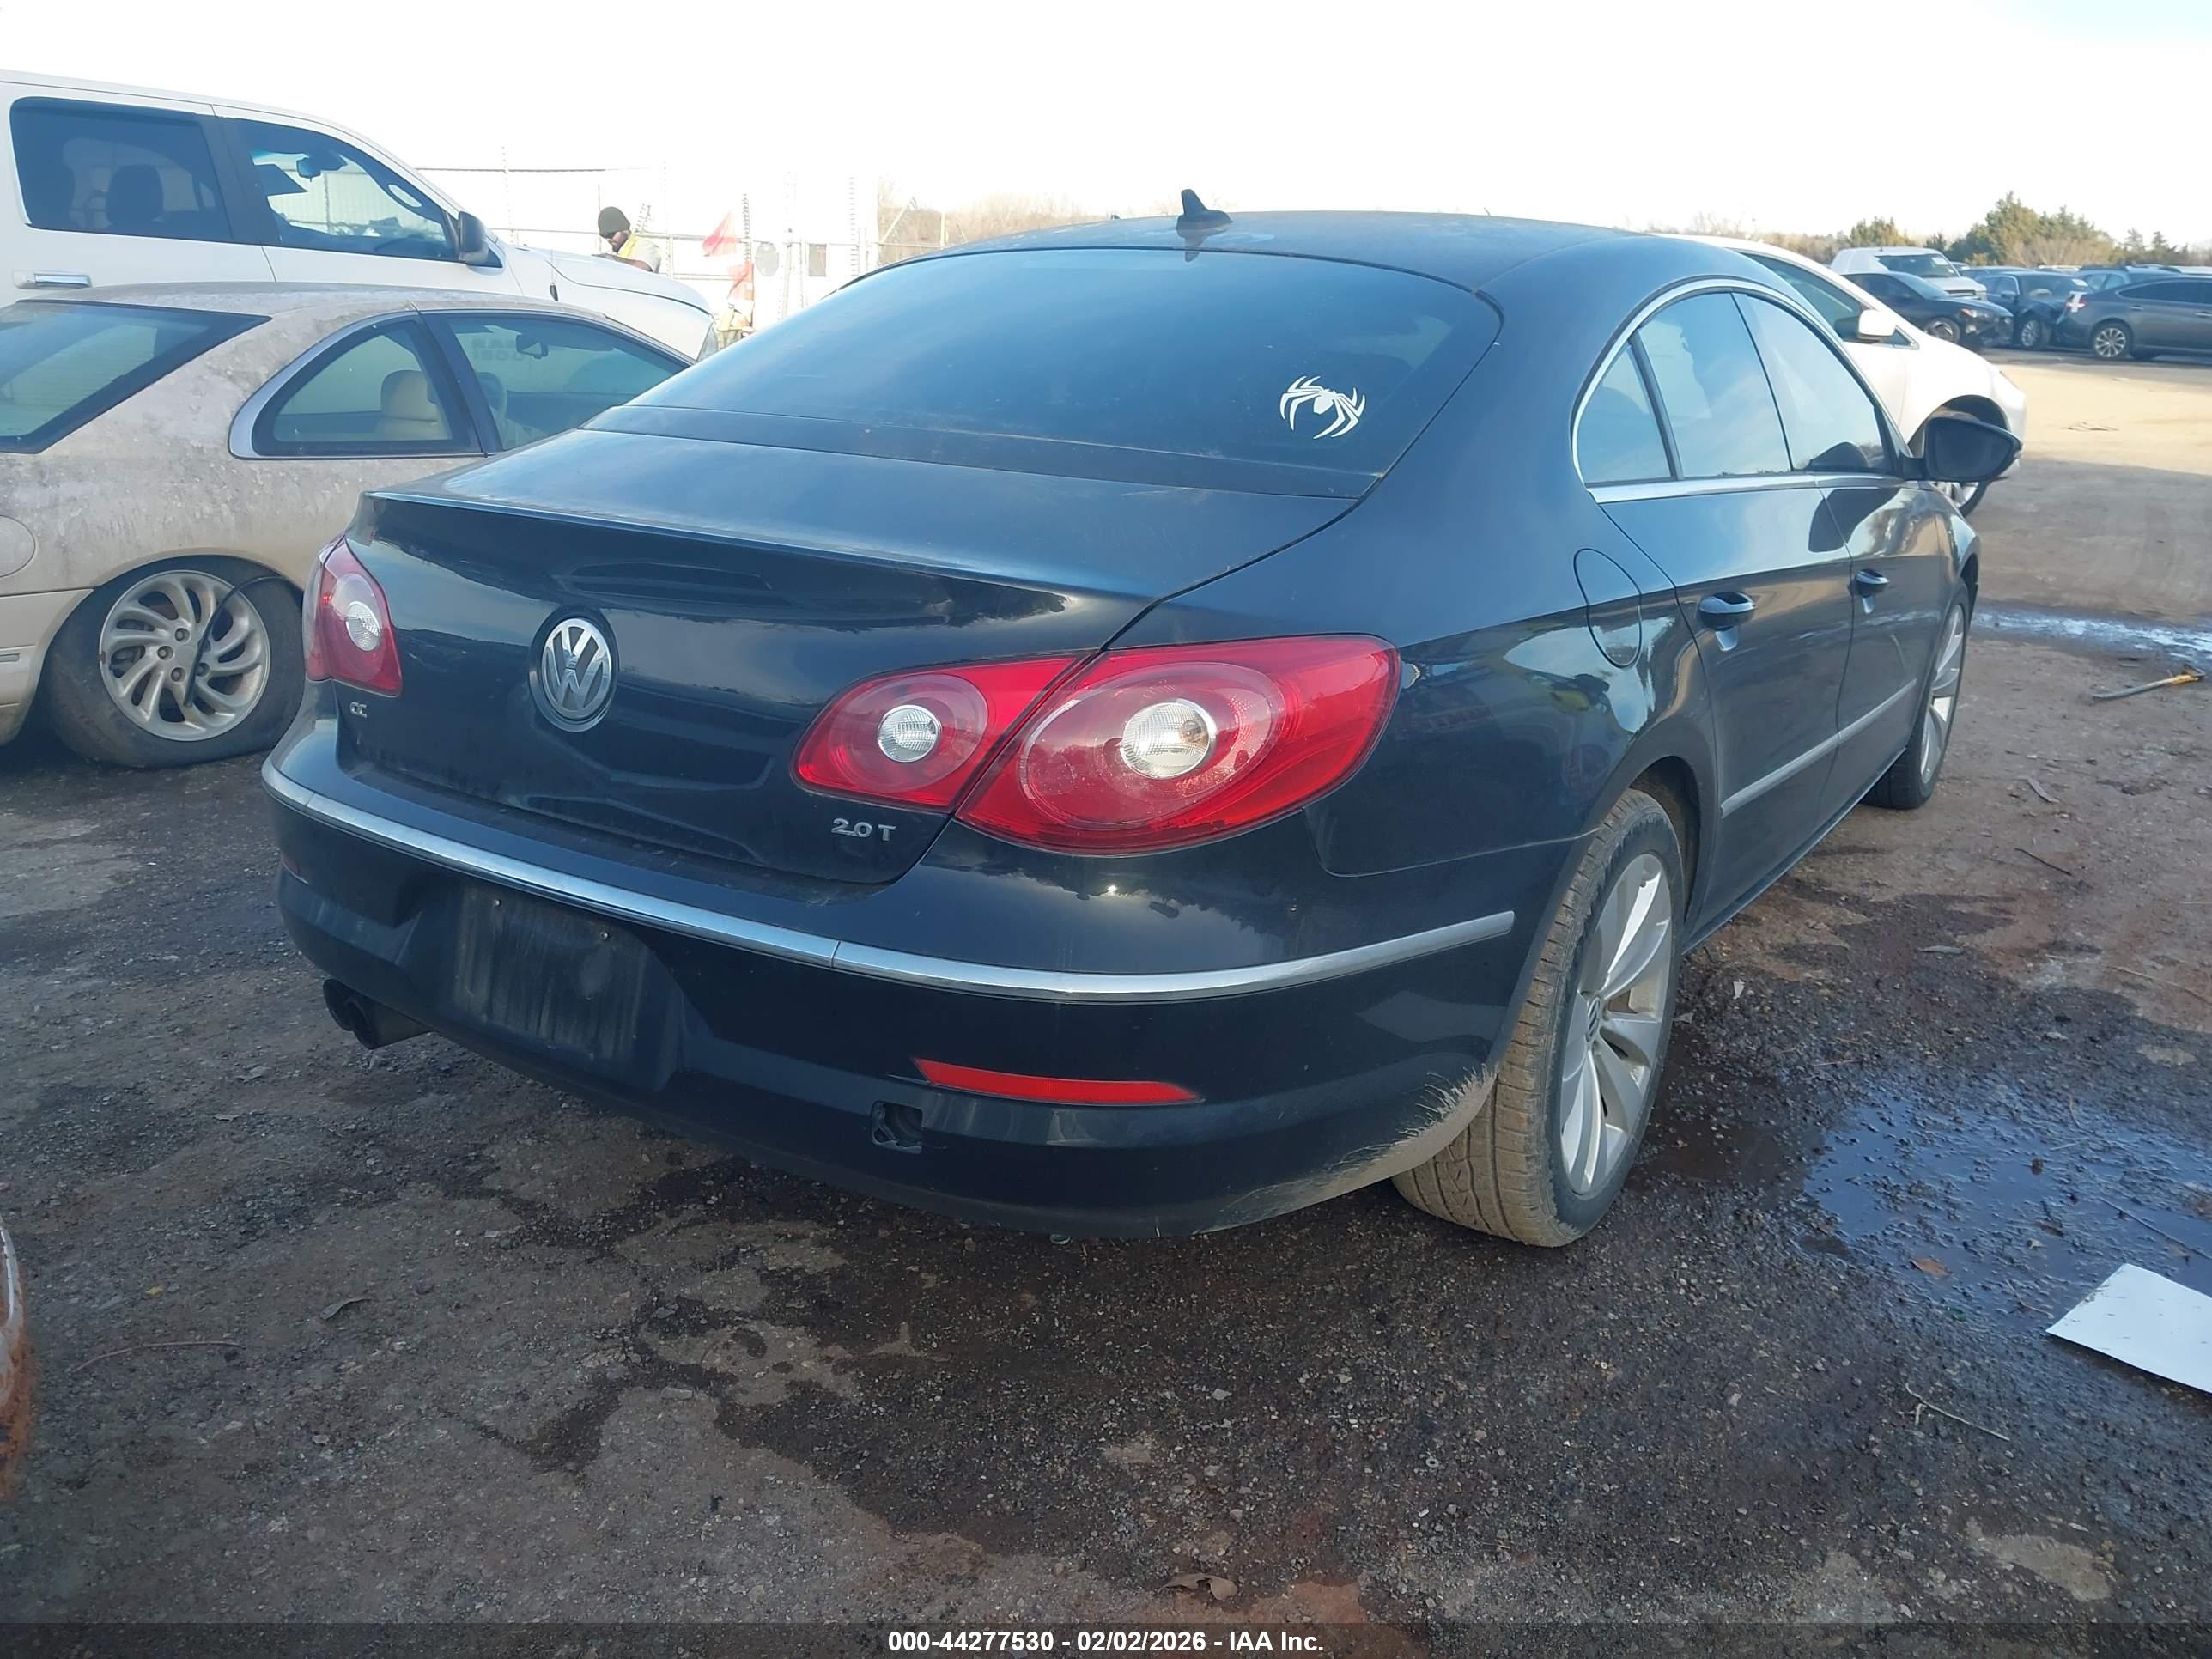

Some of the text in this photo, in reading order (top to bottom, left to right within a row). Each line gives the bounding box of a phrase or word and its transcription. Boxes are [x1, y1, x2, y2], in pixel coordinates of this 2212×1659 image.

[542, 618, 612, 719] VW
[349, 702, 368, 719] CC
[878, 823, 897, 842] T
